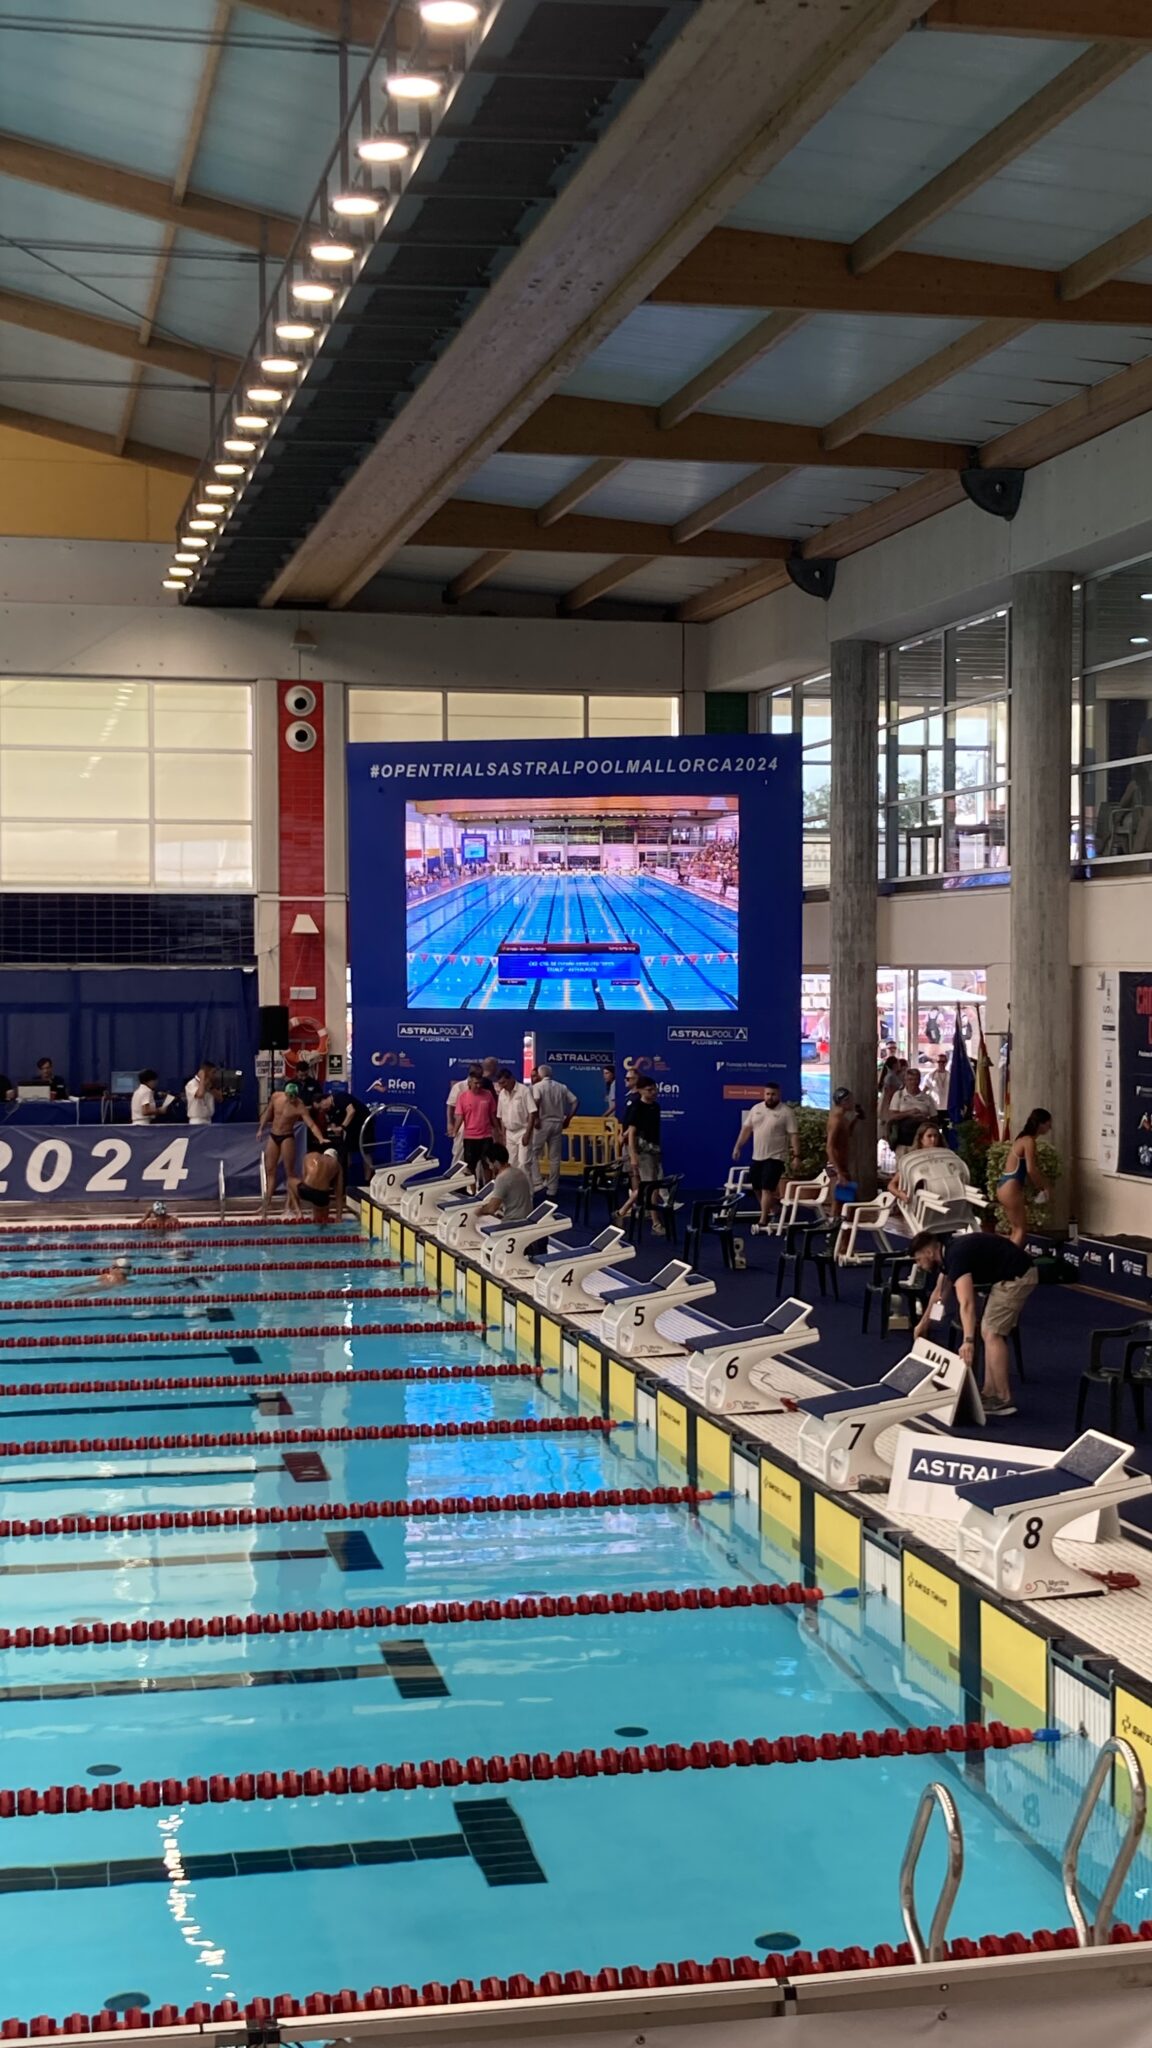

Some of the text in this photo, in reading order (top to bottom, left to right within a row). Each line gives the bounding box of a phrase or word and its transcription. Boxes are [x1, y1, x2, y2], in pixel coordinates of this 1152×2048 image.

[370, 756, 779, 778] #OPENTRIALSASTRALPOOLMALLORCA2024
[400, 1026, 459, 1035] ASTRALPOOL
[670, 1029, 733, 1038] ASTRALPOOL
[548, 1052, 612, 1062] ASTRALPOOL
[388, 1078, 416, 1089] Rfen
[656, 1082, 680, 1093] fen
[387, 1173, 396, 1186] 0
[418, 1191, 424, 1205] 1
[458, 1212, 468, 1228] 2
[505, 1237, 516, 1254] 3
[1108, 1251, 1115, 1273] 1
[561, 1268, 574, 1287] 4
[633, 1306, 645, 1326] 5
[725, 1356, 740, 1379] 6
[848, 1423, 866, 1450] 7
[1023, 1516, 1044, 1549] 8
